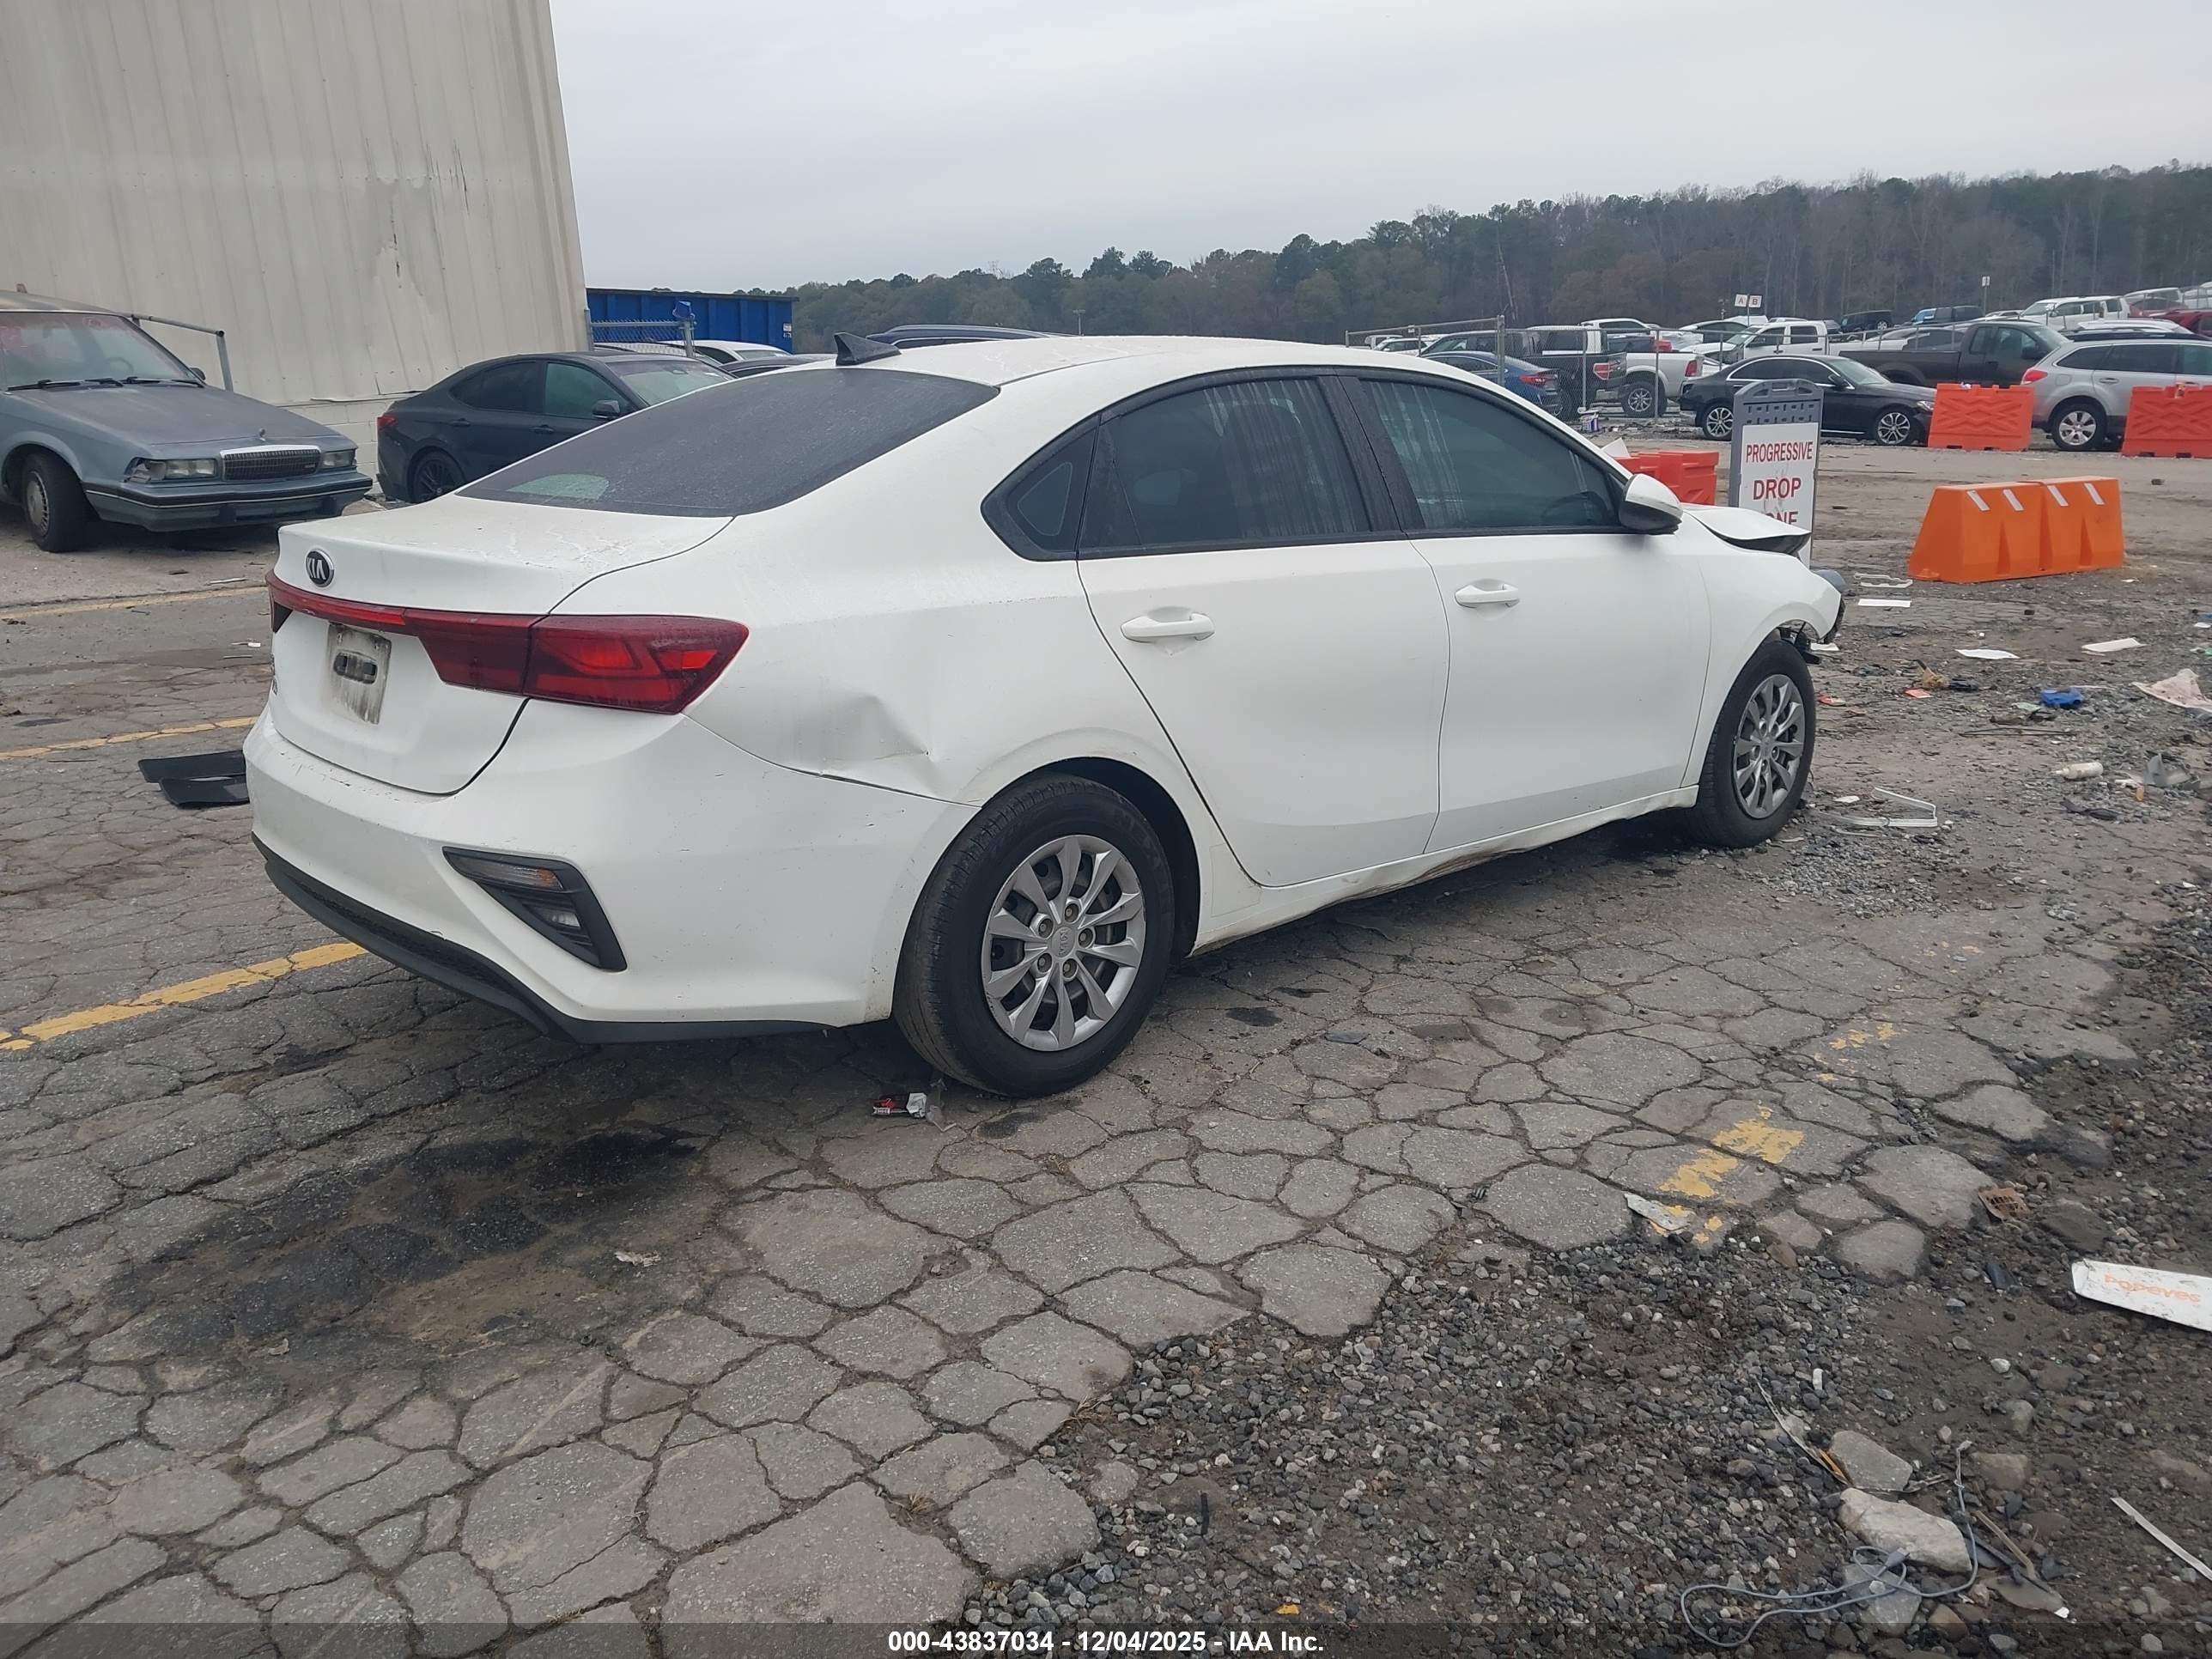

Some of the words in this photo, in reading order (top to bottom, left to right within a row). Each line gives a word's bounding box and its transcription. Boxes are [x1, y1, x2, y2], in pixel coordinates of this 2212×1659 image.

[1746, 441, 1814, 463] PROGRESSIVE
[1753, 477, 1802, 500] DROP
[307, 556, 326, 580] KIA
